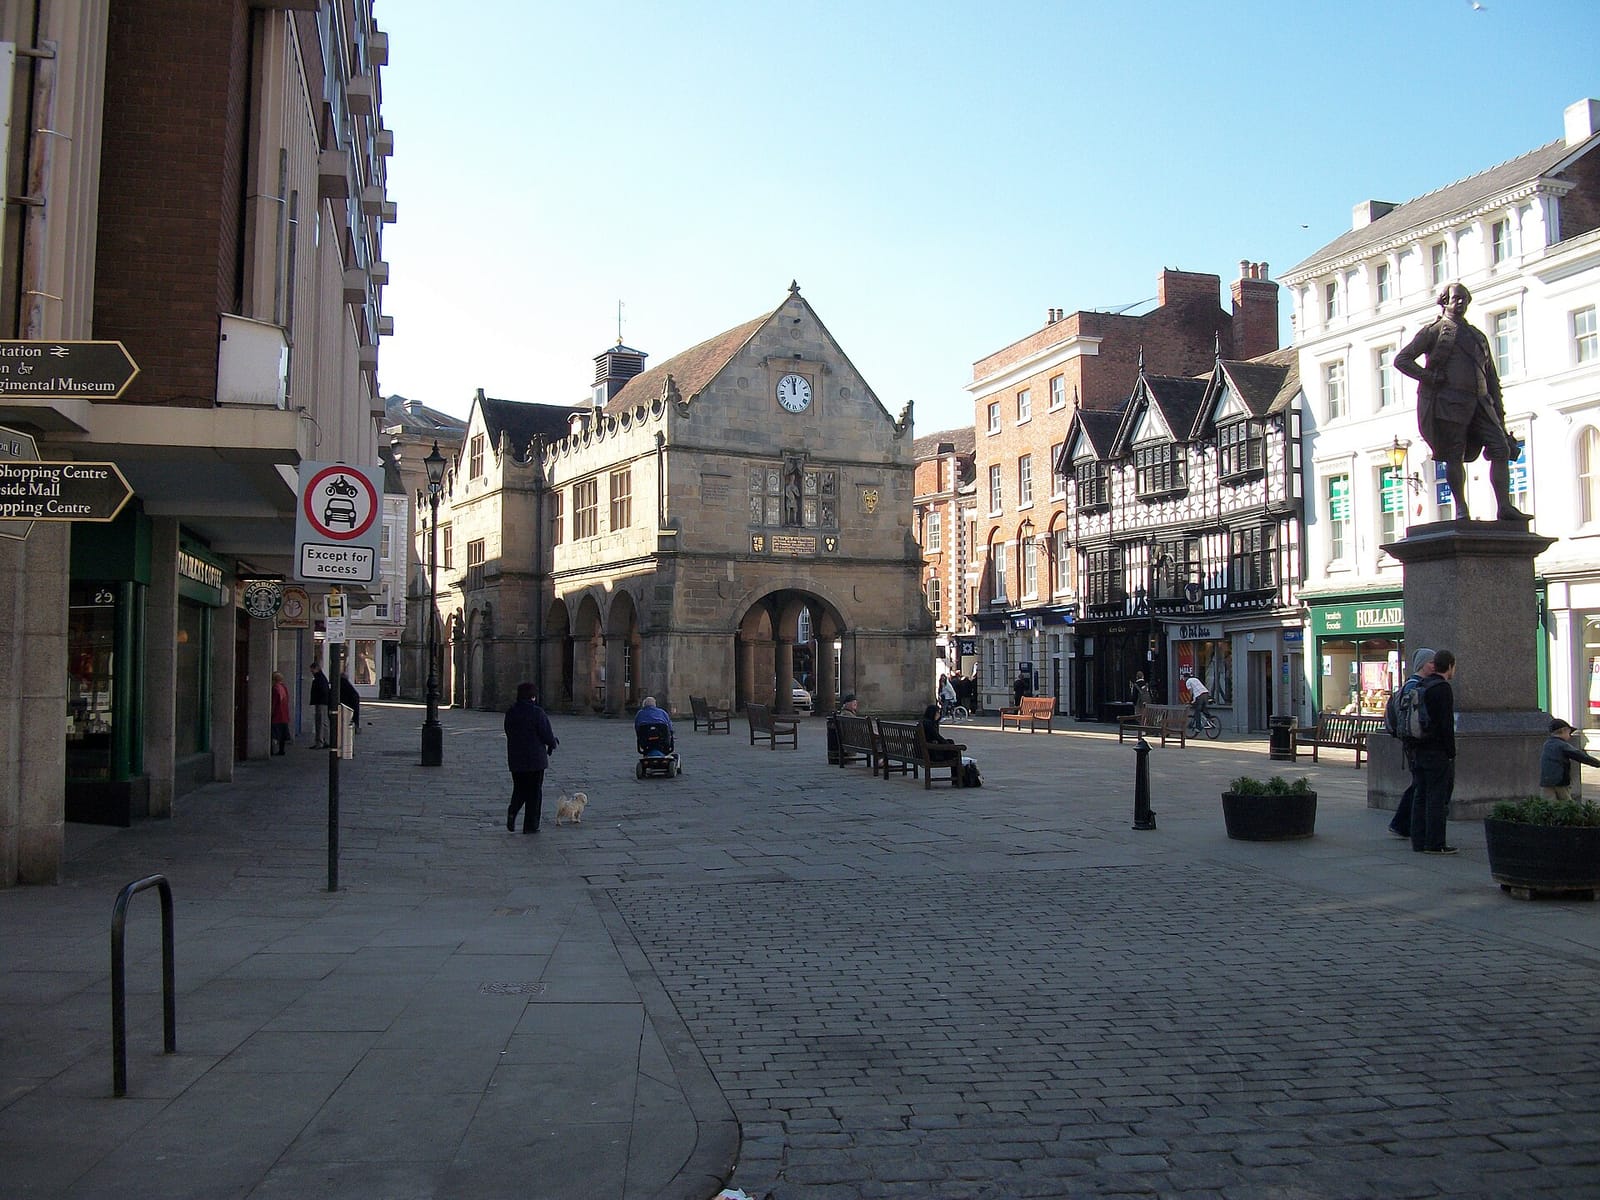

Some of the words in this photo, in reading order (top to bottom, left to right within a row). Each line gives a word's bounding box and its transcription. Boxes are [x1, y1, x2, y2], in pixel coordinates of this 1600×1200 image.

[0, 345, 42, 357] tation
[58, 378, 115, 391] Museum
[63, 465, 108, 479] Centre
[28, 483, 61, 496] Mall
[46, 500, 92, 513] Centre
[307, 548, 348, 562] Except
[352, 552, 368, 563] for
[317, 564, 358, 575] access
[245, 581, 281, 598] STARBUCKS
[249, 606, 277, 618] COFFEE
[1356, 607, 1401, 628] HOLLAND
